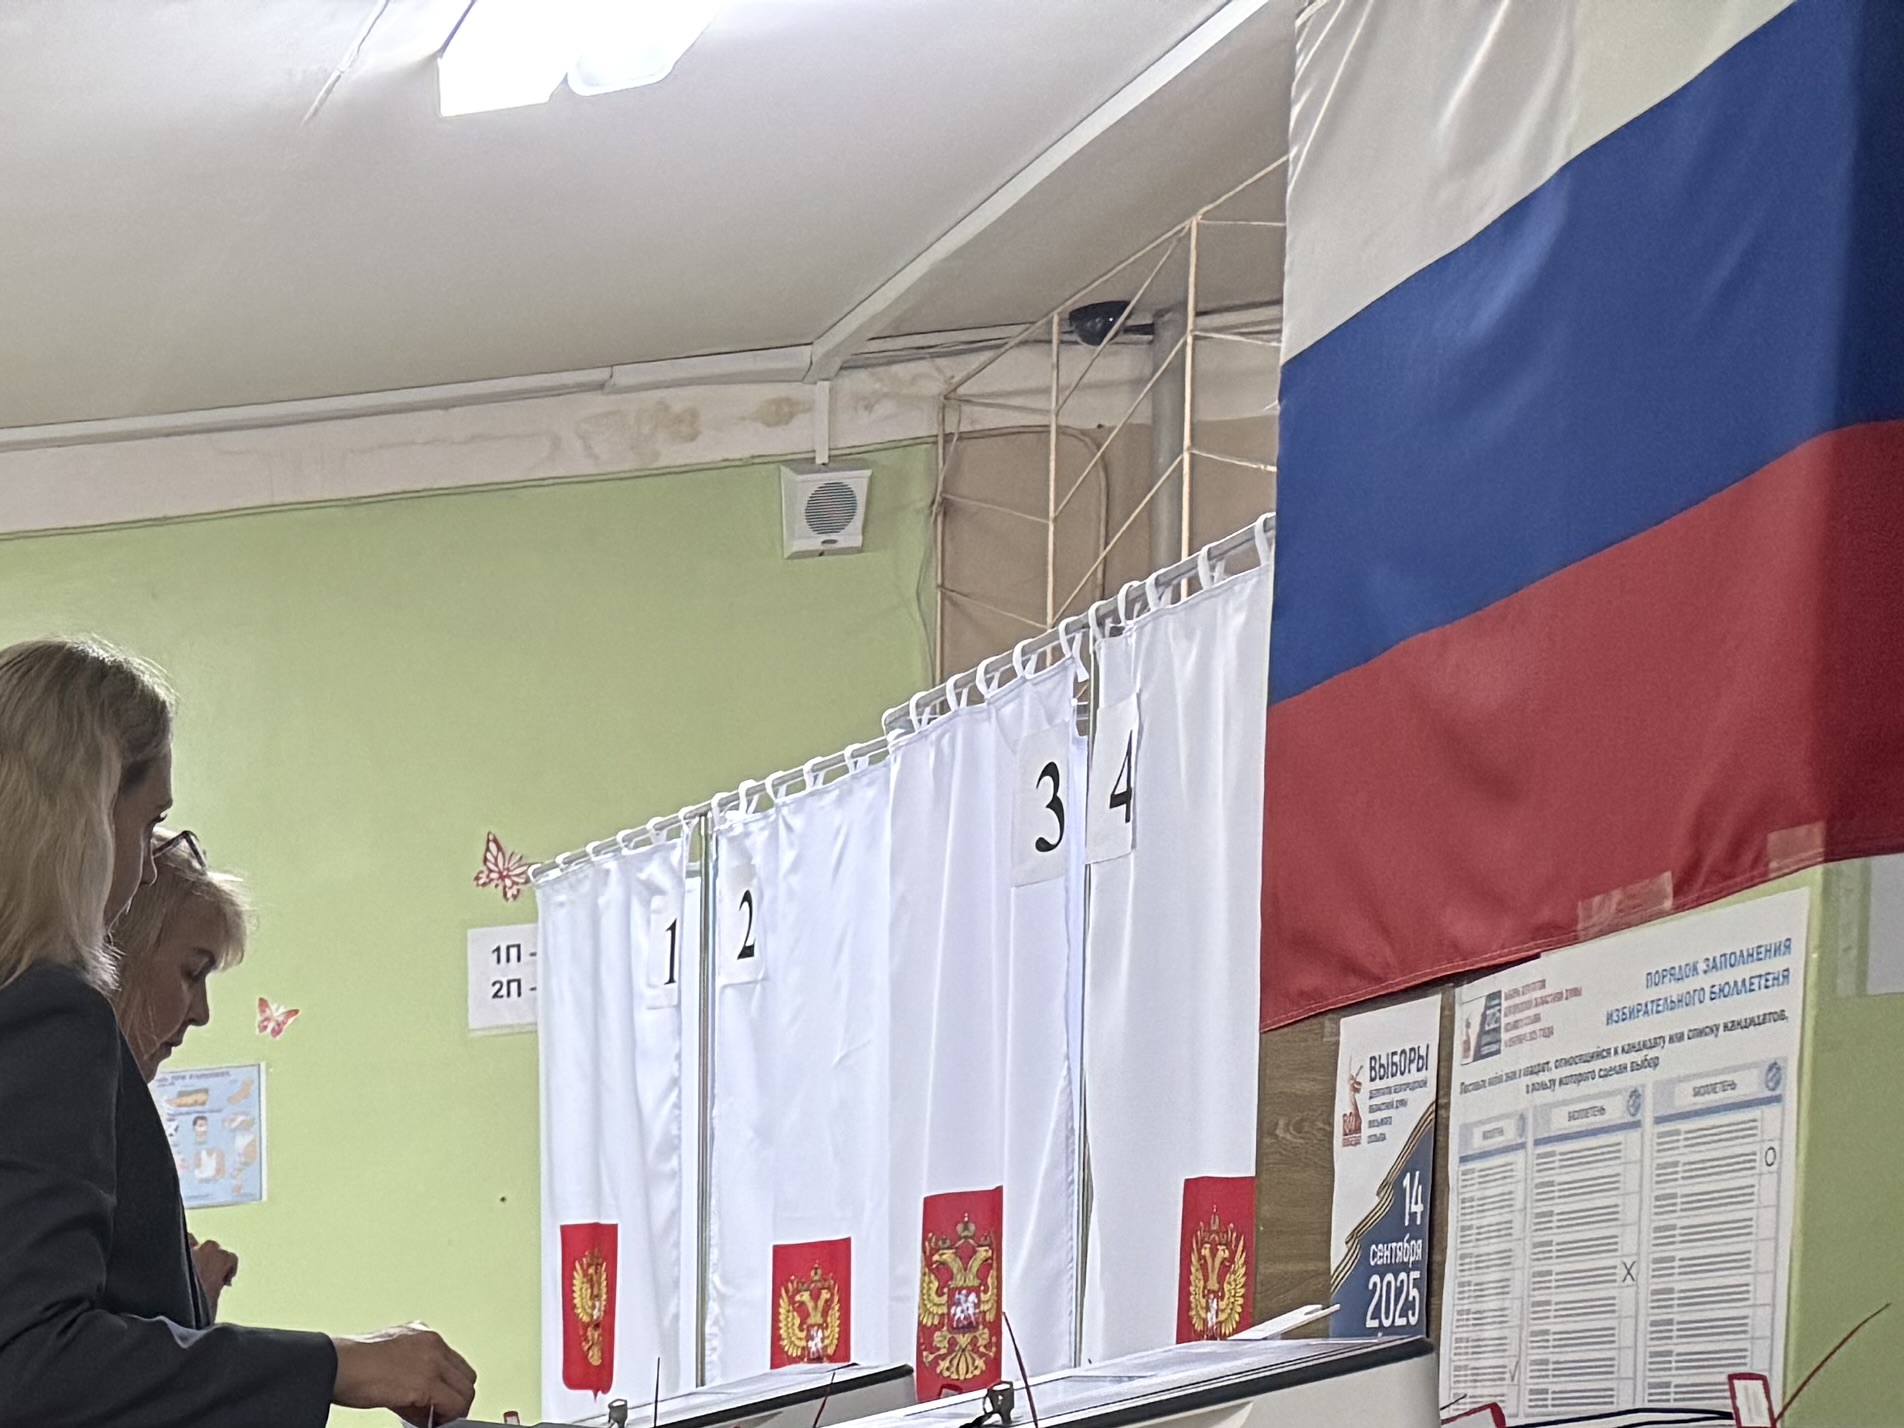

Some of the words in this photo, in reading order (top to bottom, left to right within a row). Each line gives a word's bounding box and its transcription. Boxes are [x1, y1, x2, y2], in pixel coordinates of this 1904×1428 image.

[1109, 730, 1133, 824] 4
[1034, 762, 1065, 853] 3
[663, 918, 677, 986] 1
[737, 890, 755, 960] 2
[492, 943, 522, 965] 1П
[1646, 961, 1699, 989] ПОРЯДОК
[1702, 938, 1791, 975] ЗАПОЛНЕНИЯ
[491, 978, 522, 999] 2П
[1606, 988, 1706, 1026] ИЗБИРАТЕЛЬНОГО
[1709, 968, 1790, 1001] БЮЛЛЕТЕНЯ
[1369, 1043, 1429, 1082] ВЫБОРЫ
[1402, 1170, 1423, 1226] 14
[1369, 1233, 1422, 1269] сентября
[1366, 1270, 1421, 1329] 2025
